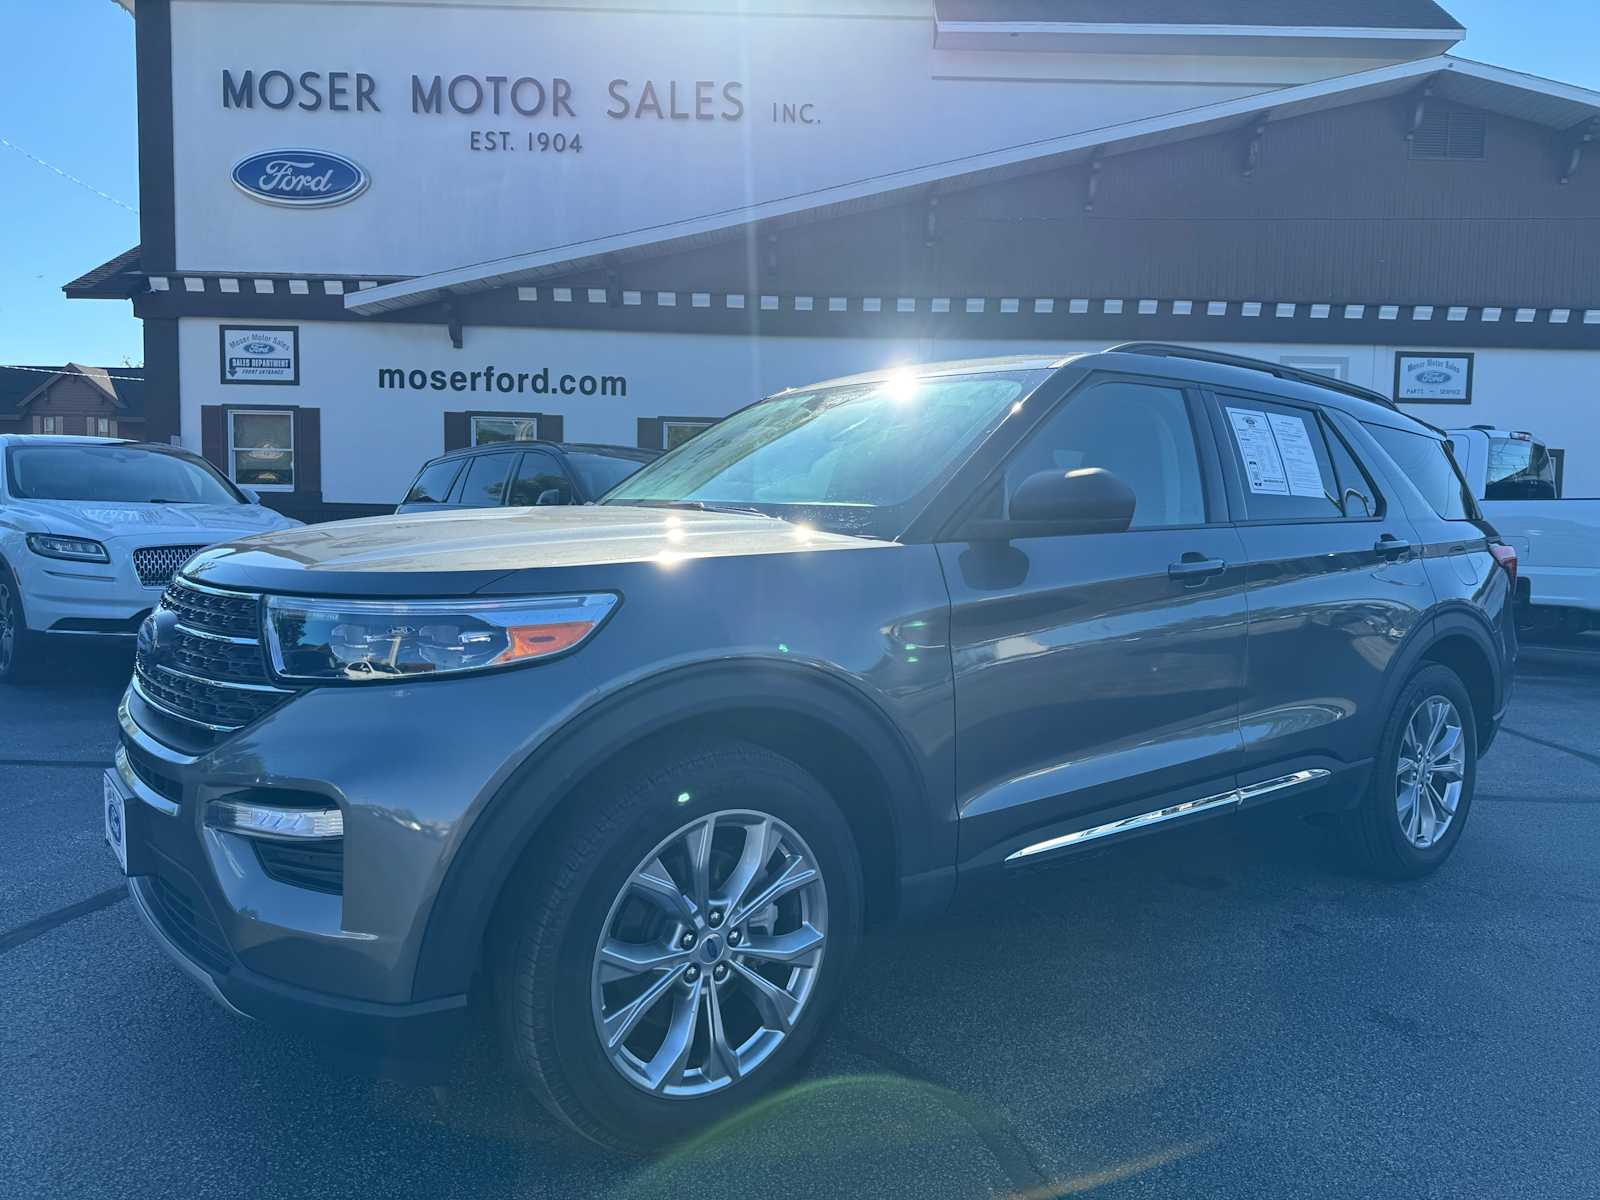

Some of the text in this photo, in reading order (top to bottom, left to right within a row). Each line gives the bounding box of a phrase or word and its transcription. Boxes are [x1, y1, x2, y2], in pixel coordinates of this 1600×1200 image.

[221, 69, 822, 125] MOSER MOTOR SALES INC.
[469, 131, 583, 153] EST. 1904
[258, 161, 333, 193] Ford
[251, 359, 289, 368] DEPARTMENT
[378, 365, 627, 397] moserford.com
